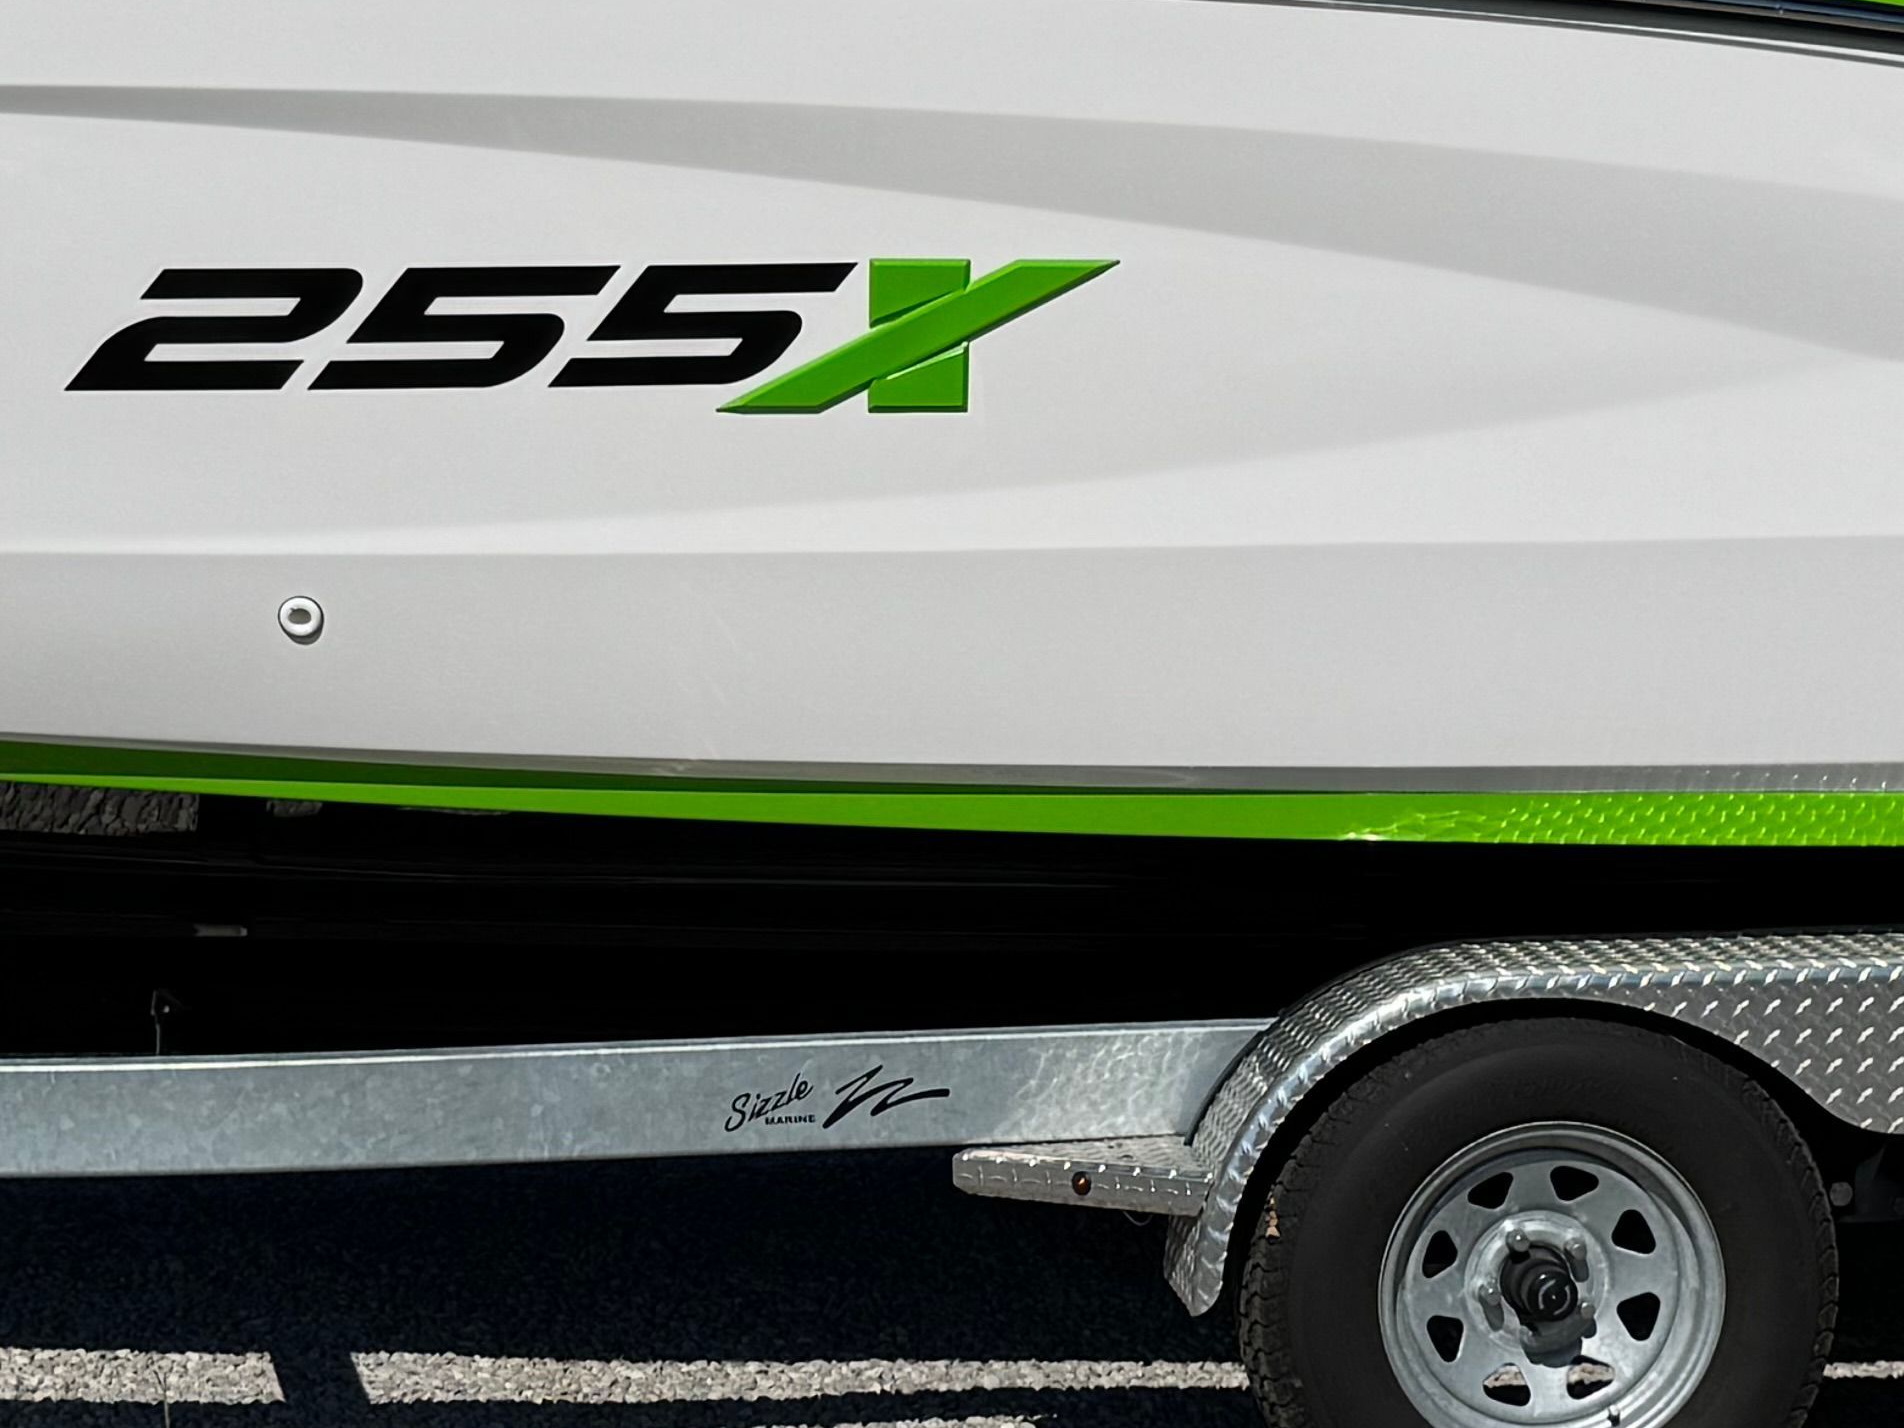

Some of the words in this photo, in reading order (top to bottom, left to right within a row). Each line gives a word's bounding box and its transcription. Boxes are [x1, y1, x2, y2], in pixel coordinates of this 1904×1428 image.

[66, 259, 1120, 413] 255X
[724, 1072, 814, 1132] Sizzle
[765, 1113, 816, 1126] MARINE
